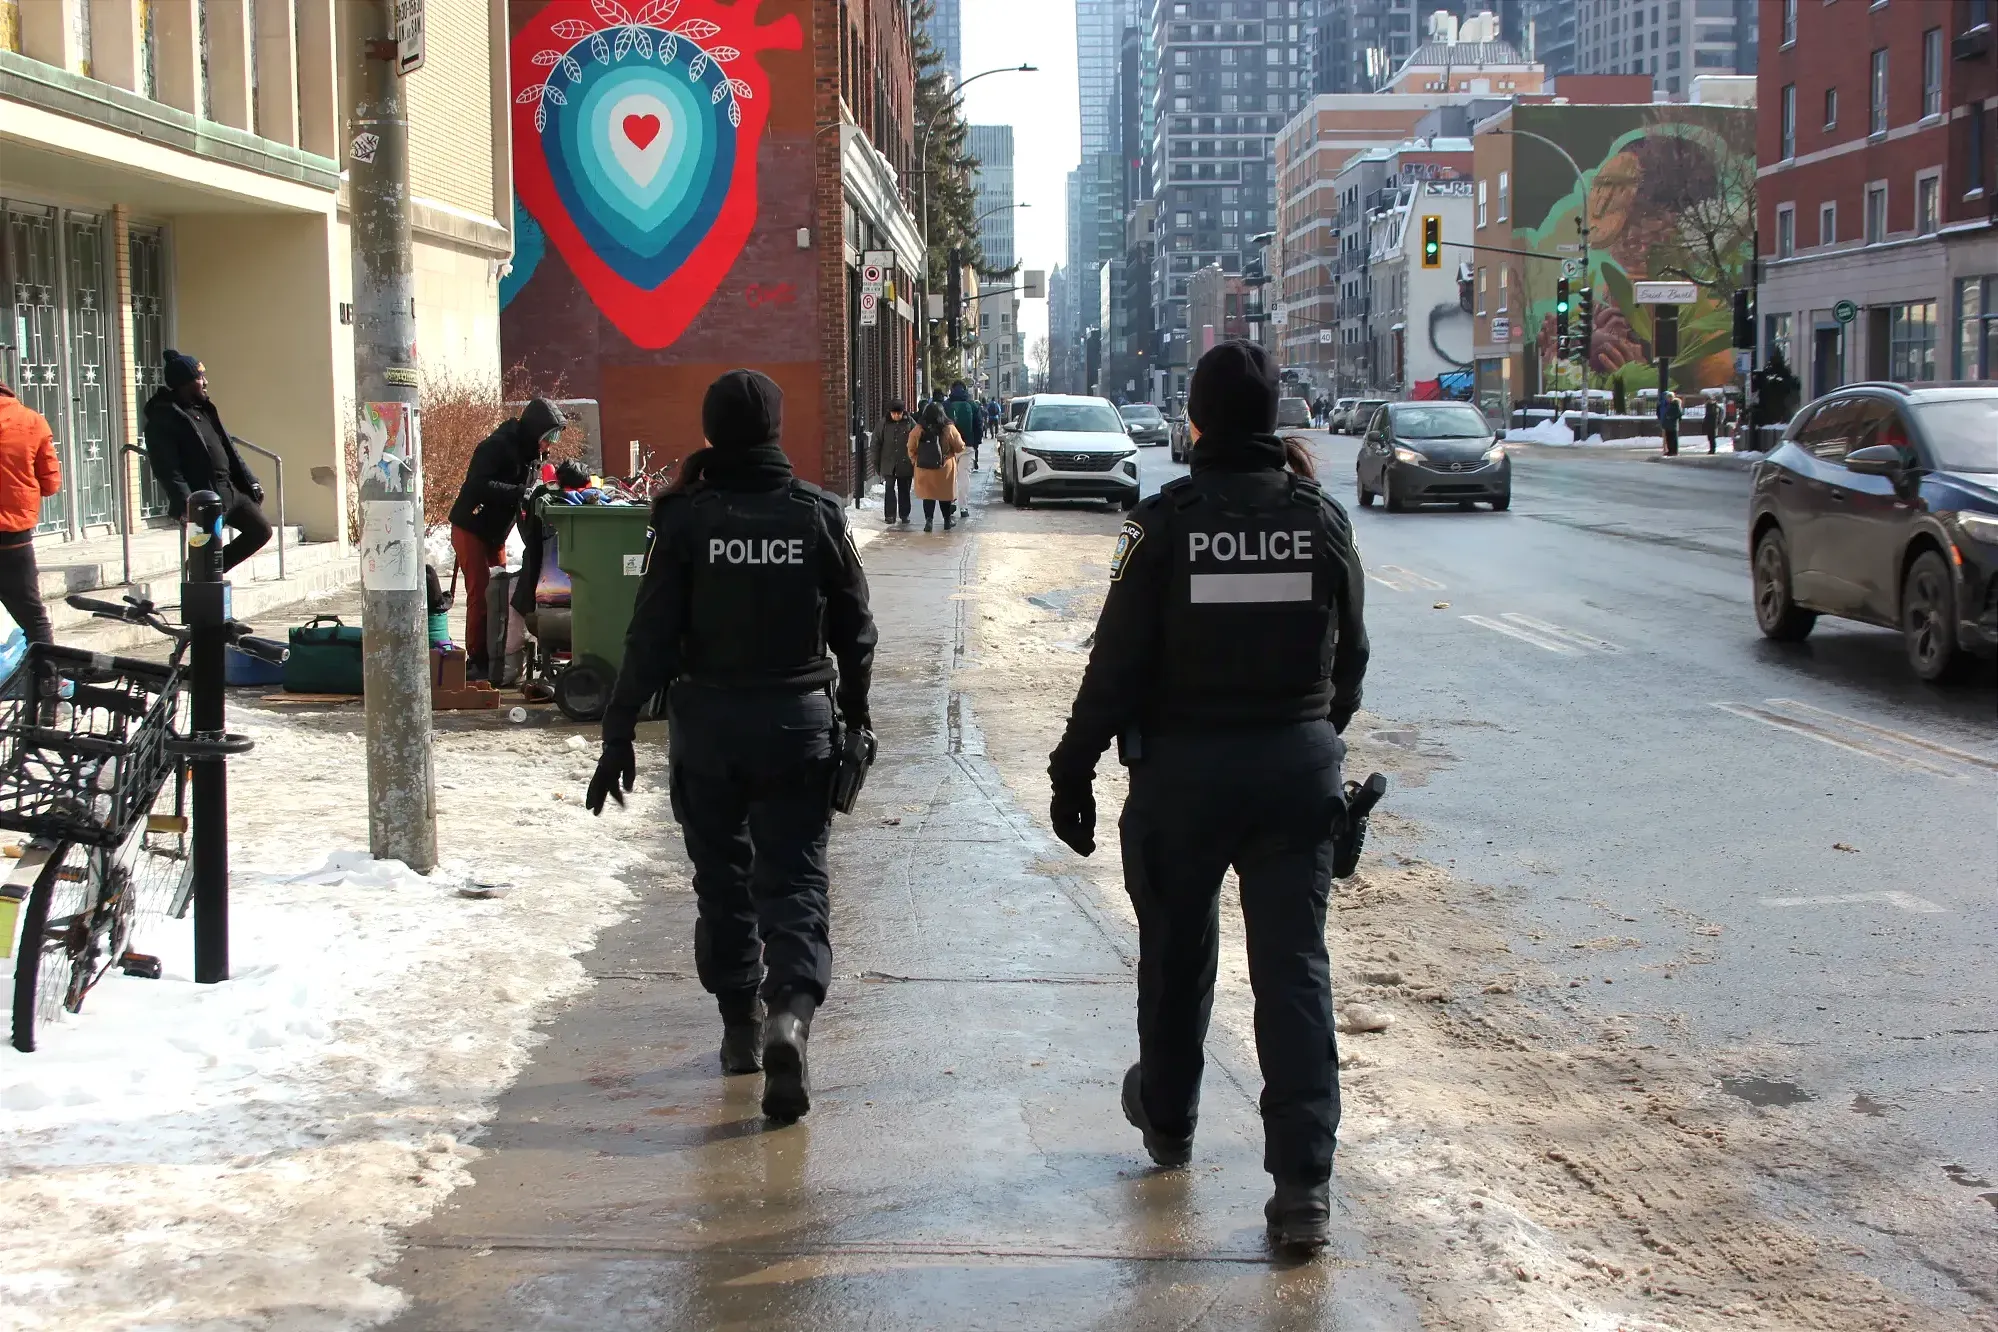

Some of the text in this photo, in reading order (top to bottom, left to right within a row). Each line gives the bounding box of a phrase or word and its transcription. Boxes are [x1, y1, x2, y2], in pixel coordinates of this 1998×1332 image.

[1321, 333, 1331, 342] 40
[709, 538, 804, 564] POLICE
[1189, 530, 1313, 562] POLICE
